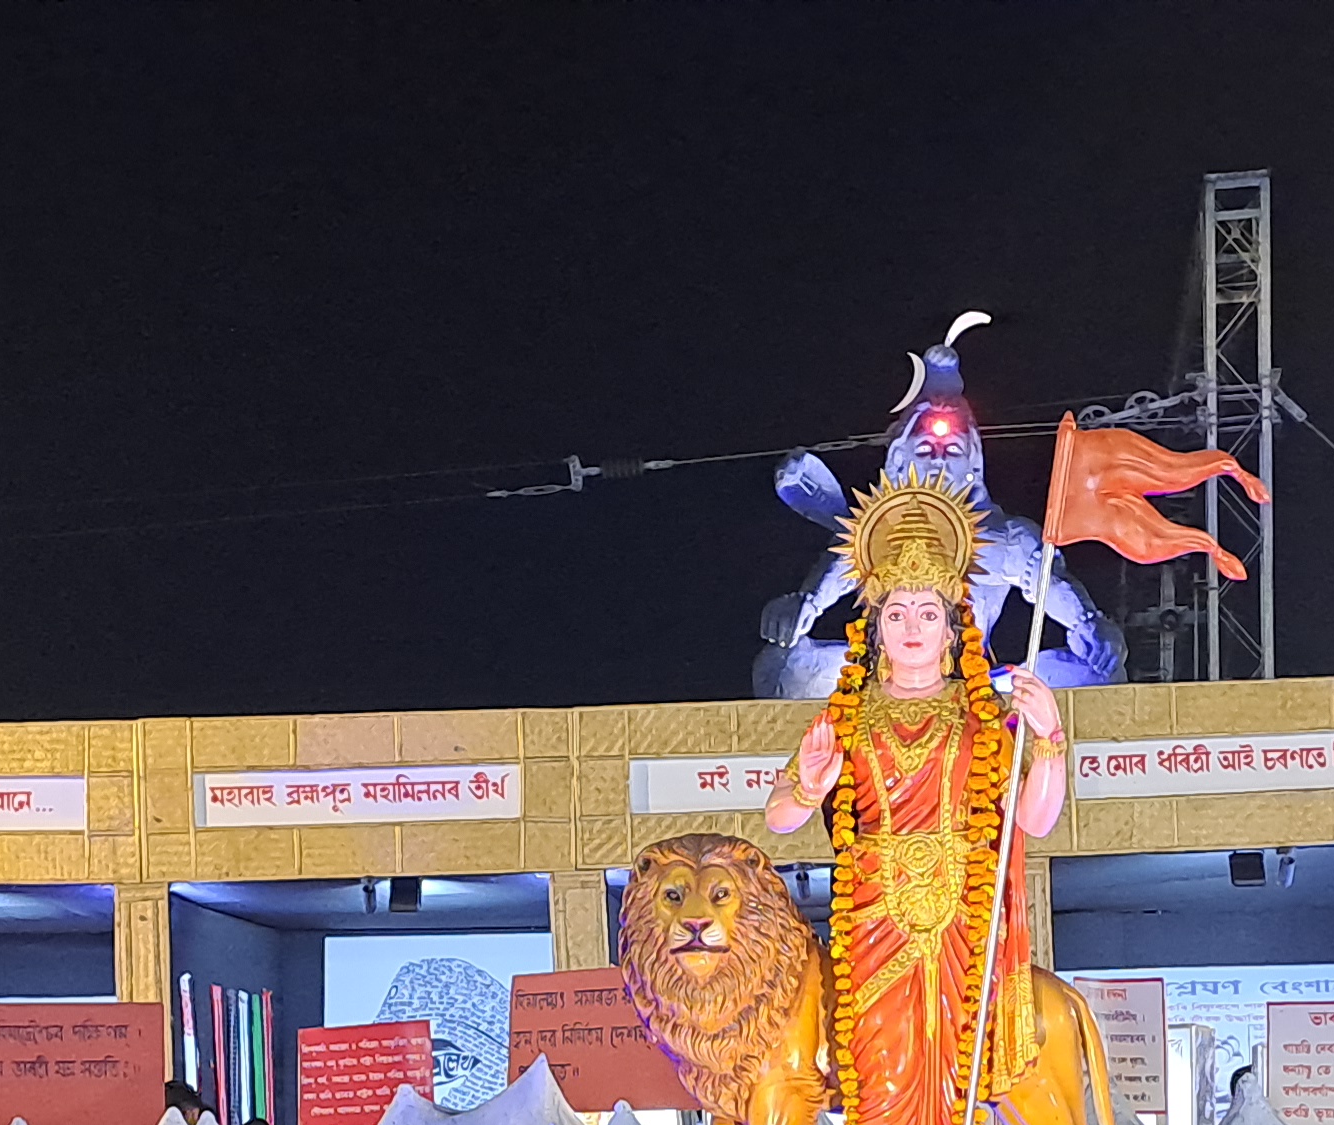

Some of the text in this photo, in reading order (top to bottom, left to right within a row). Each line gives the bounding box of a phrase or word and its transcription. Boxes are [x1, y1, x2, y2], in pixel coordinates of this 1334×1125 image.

[1080, 755, 1102, 778] হে
[1106, 753, 1147, 777] মোৰ
[1156, 743, 1212, 774] ধৰিত্ৰী
[1217, 743, 1257, 772] আই
[1261, 746, 1327, 771] চৰণতে
[209, 783, 276, 809] মহাবাহু
[360, 773, 461, 805] মহামিলনৰ
[468, 771, 511, 801] তীৰ্থ
[697, 765, 730, 792] মই
